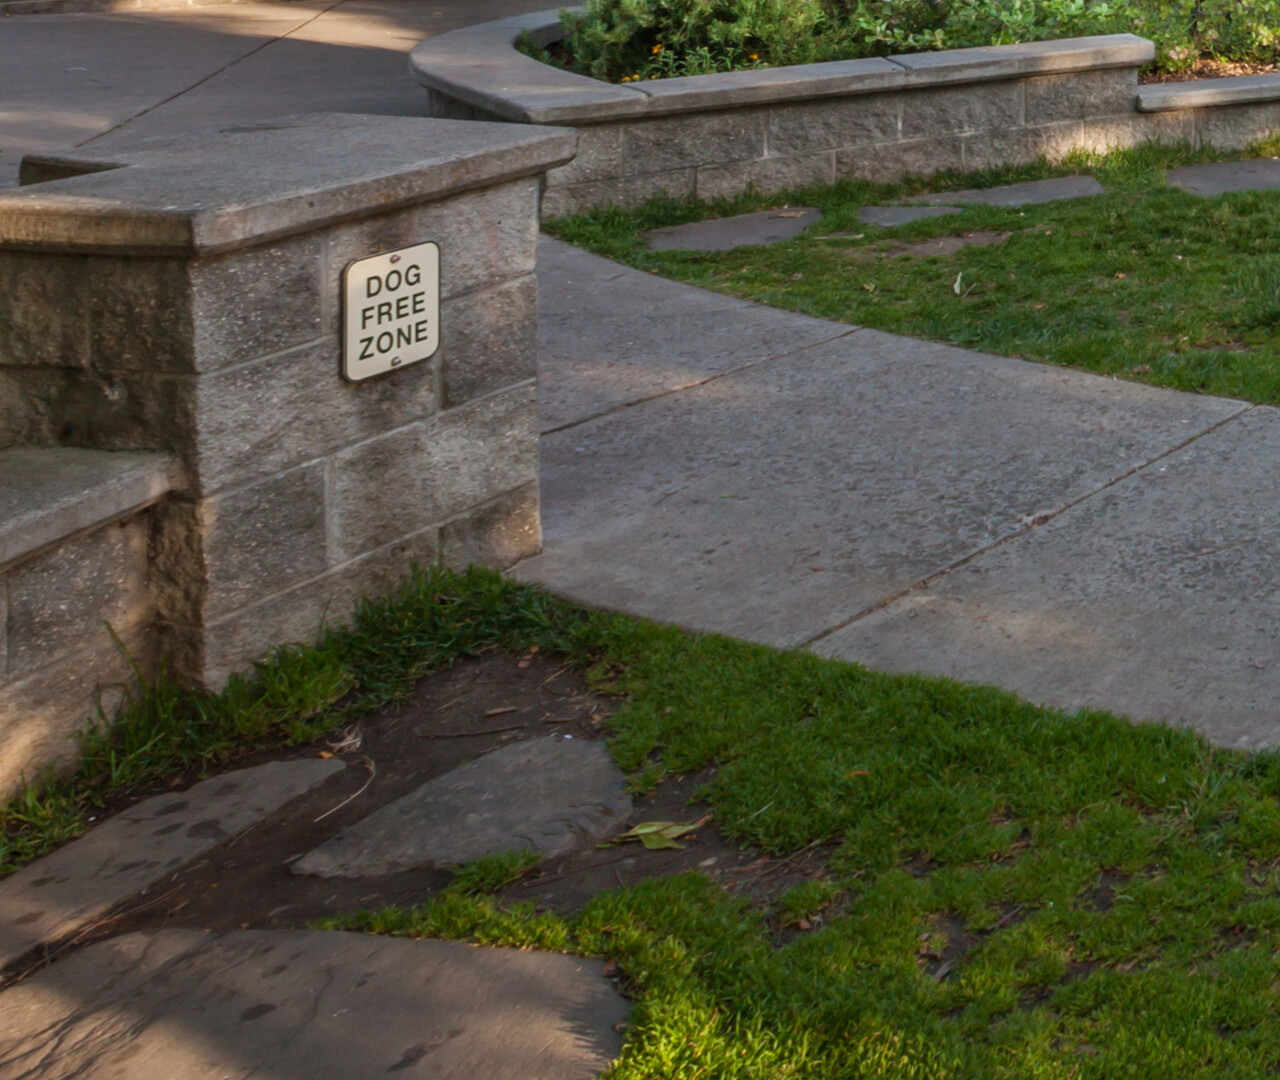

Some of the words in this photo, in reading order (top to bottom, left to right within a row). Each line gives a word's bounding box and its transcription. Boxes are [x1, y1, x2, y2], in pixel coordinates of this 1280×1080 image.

[366, 264, 421, 298] DOG
[361, 291, 426, 330] FREE
[358, 319, 428, 361] ZONE
